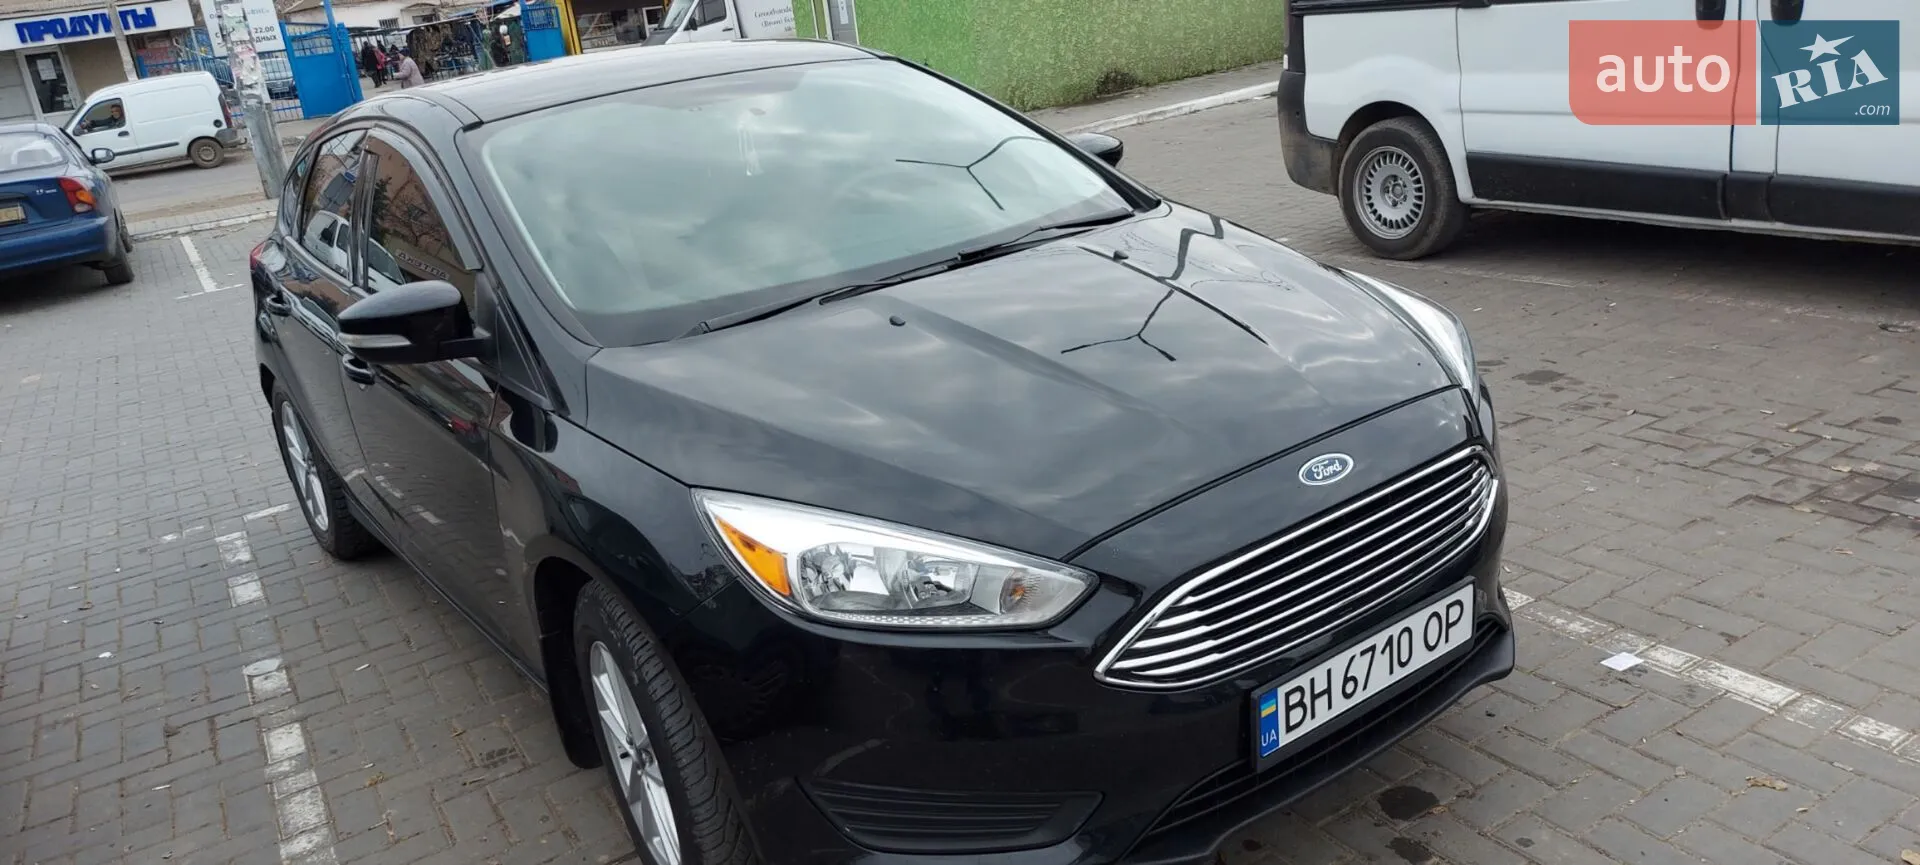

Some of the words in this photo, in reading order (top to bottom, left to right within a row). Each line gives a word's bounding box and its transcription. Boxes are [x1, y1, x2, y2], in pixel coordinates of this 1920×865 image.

[254, 25, 275, 34] 22.00
[1311, 459, 1343, 480] Ford
[1284, 667, 1333, 735] BH
[1341, 626, 1413, 700] 6710
[1423, 599, 1464, 652] OP
[1261, 728, 1278, 747] UA
